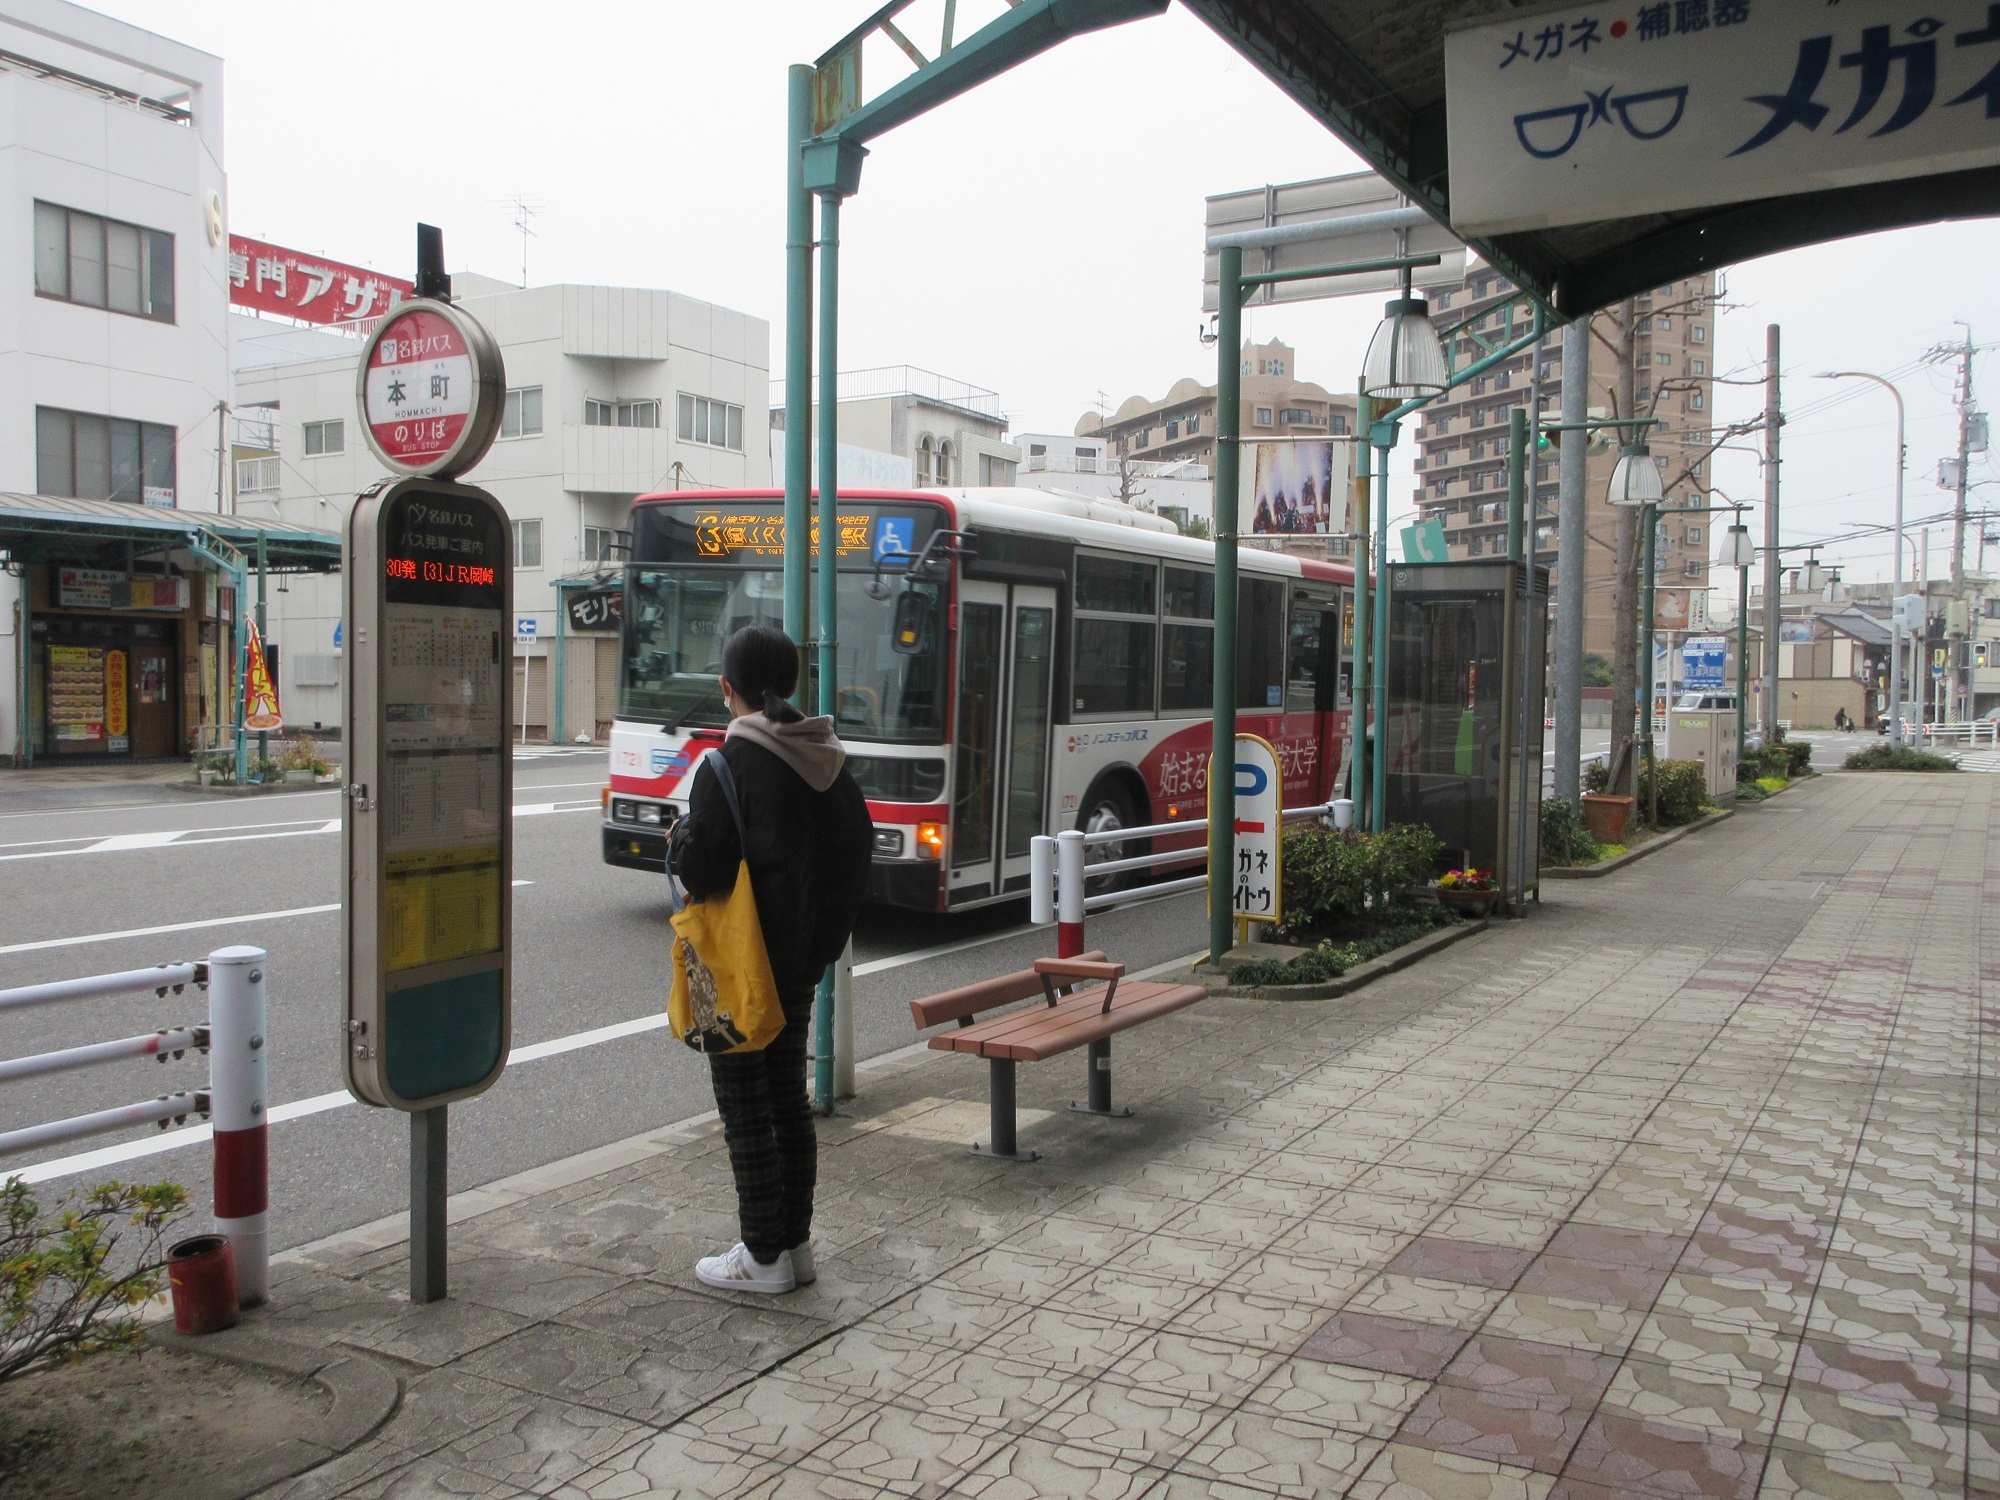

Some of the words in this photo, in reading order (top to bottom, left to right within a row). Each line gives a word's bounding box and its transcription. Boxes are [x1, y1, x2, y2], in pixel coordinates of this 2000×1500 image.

[1499, 17, 1602, 69] メガネ
[1636, 0, 1750, 42] 補聴器
[399, 336, 452, 358] 名鉄バス
[387, 375, 450, 407] 本町
[395, 407, 443, 419] HOMMACHI
[395, 419, 447, 443] のりば
[403, 444, 417, 452] BUS
[421, 443, 440, 451] STOP
[429, 509, 474, 527] 名鉄バス
[401, 532, 484, 555] バス発車ご案内
[1092, 729, 1148, 745] ノンステップバス
[1159, 751, 1207, 798] 始まる
[1238, 848, 1269, 875] ガネ
[1233, 884, 1271, 912] イトウ
